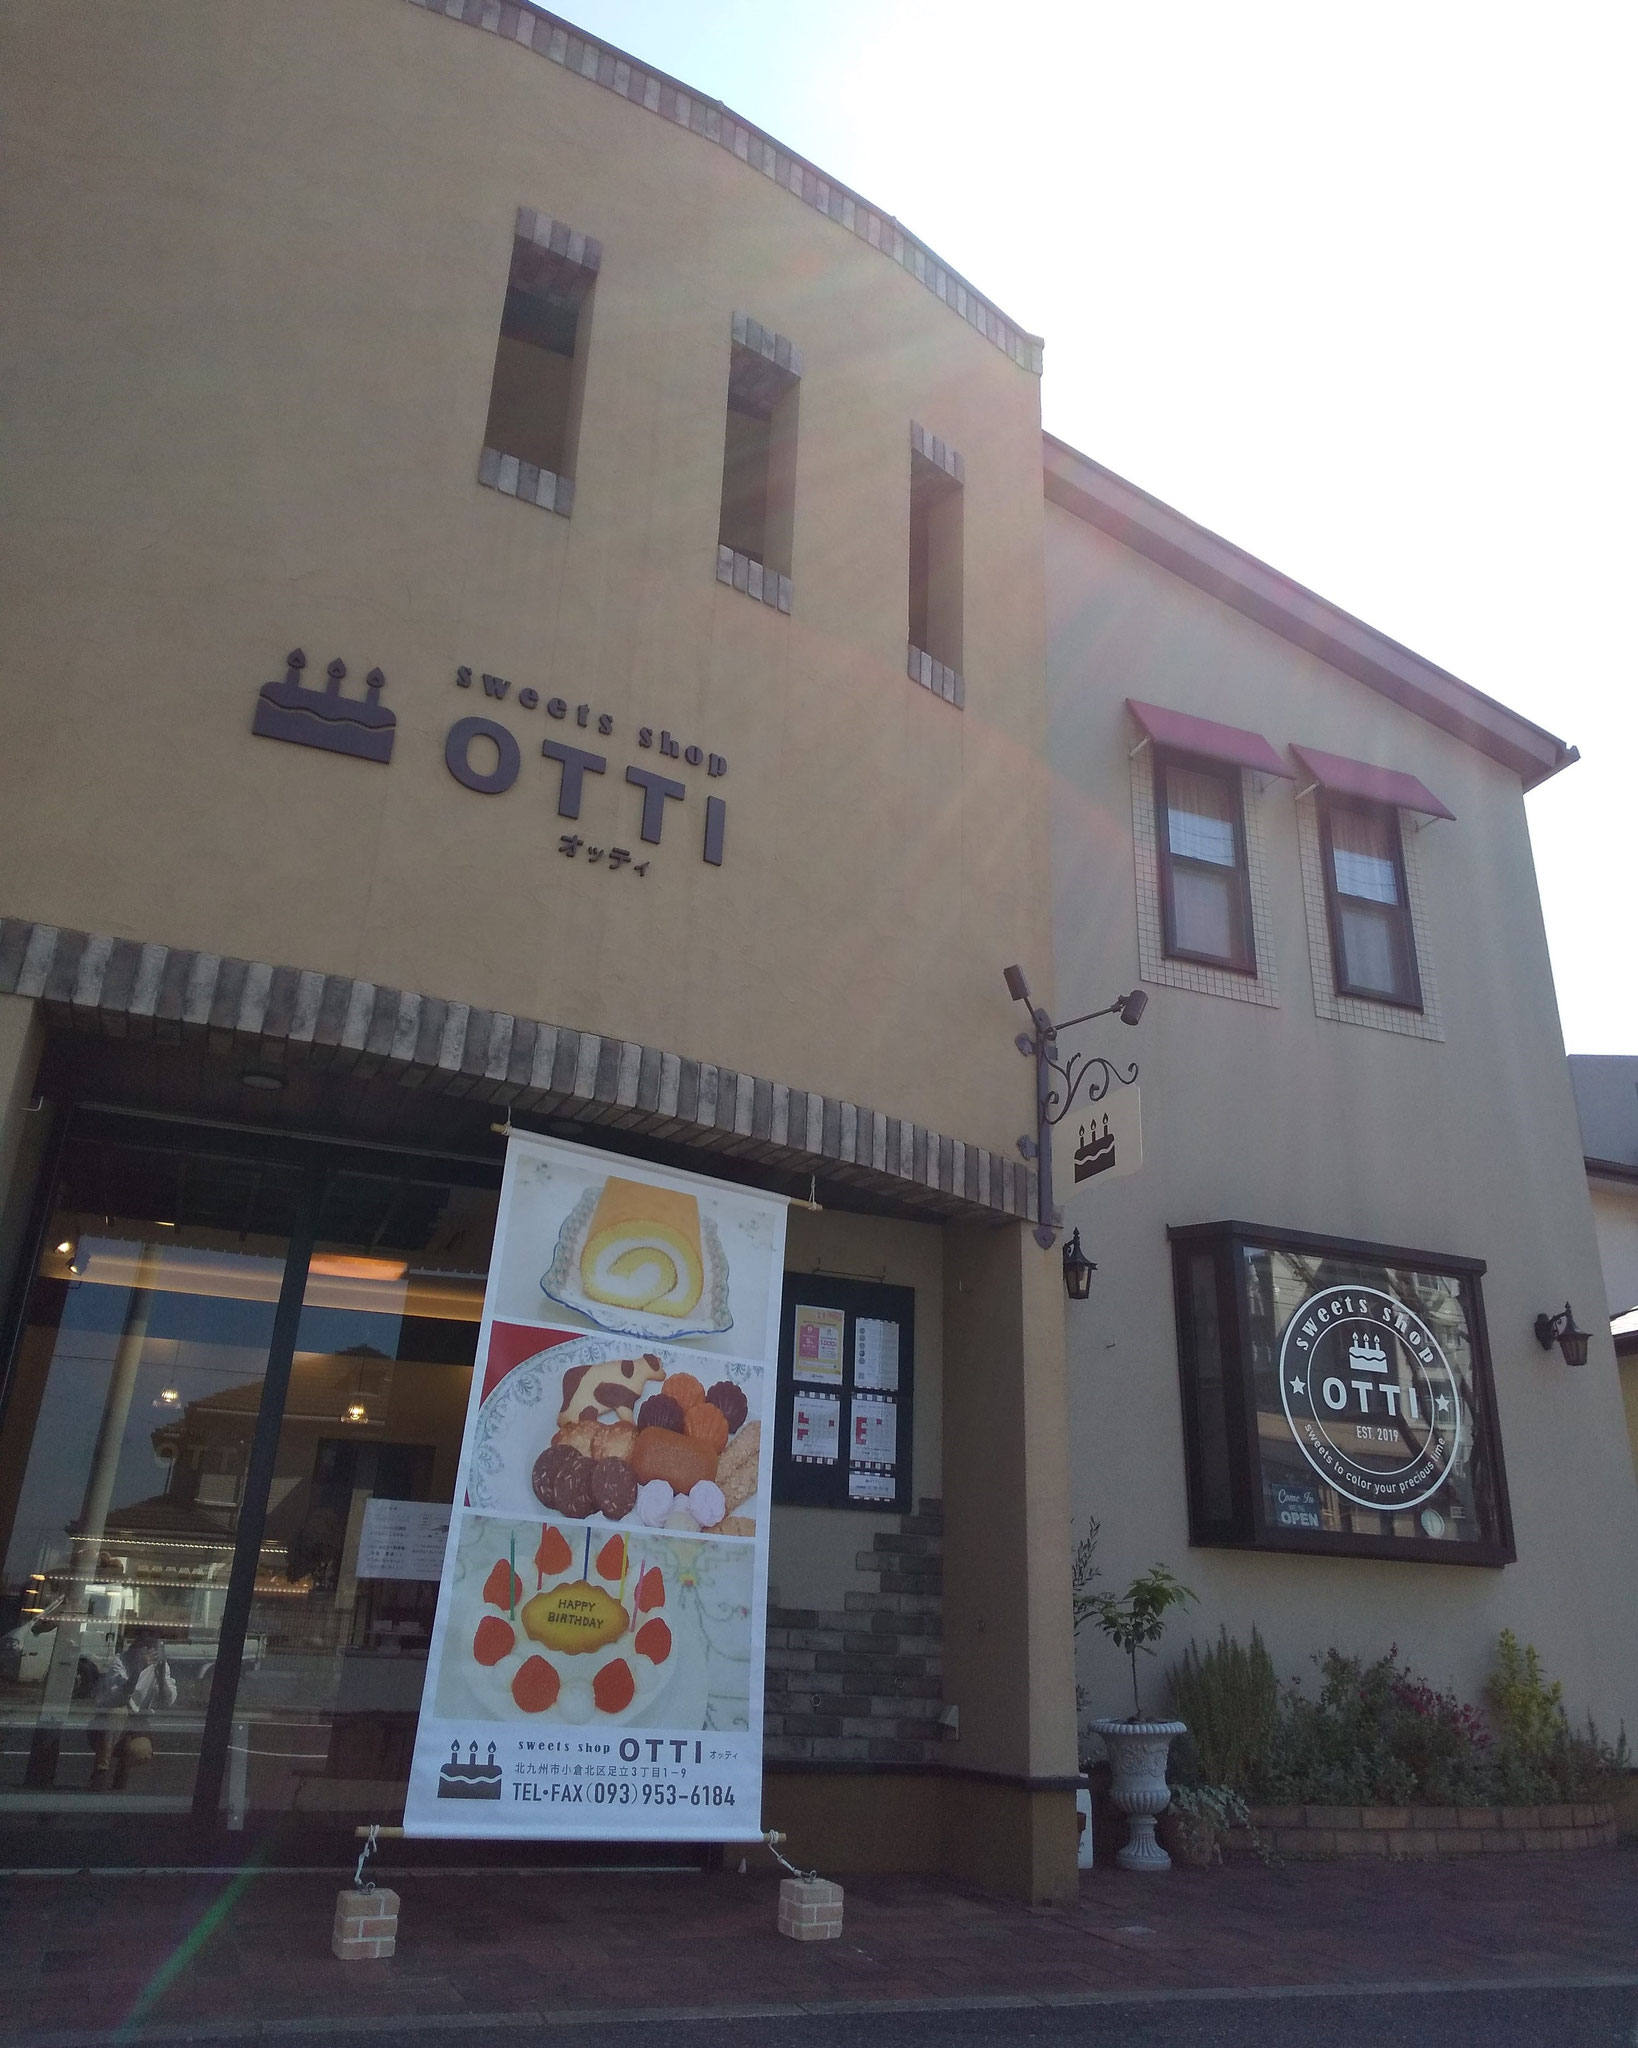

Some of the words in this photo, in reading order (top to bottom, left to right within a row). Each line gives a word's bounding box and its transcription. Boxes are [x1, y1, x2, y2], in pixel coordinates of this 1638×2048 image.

[456, 665, 614, 736] sweets
[638, 726, 728, 778] shop
[444, 716, 727, 867] OTTI
[558, 834, 651, 878] オッティ
[1296, 1296, 1368, 1351] sweets
[1382, 1306, 1435, 1364] shop
[1322, 1377, 1419, 1419] OTTI
[1356, 1425, 1375, 1440] EST.
[1378, 1427, 1399, 1442] 2019
[1304, 1423, 1333, 1464] sweets
[1334, 1461, 1344, 1475] to
[1345, 1471, 1372, 1491] color
[1374, 1483, 1397, 1495] your
[1399, 1460, 1435, 1494] precious
[1430, 1436, 1446, 1463] time
[1278, 1488, 1300, 1504] Come
[1281, 1510, 1319, 1527] OPEN
[547, 1612, 604, 1629] BIRTHDAY
[558, 1599, 596, 1612] HAPPY
[518, 1740, 570, 1752] sweets
[577, 1742, 611, 1755] shop
[619, 1737, 702, 1764] OTTI
[709, 1750, 738, 1760] オッティ
